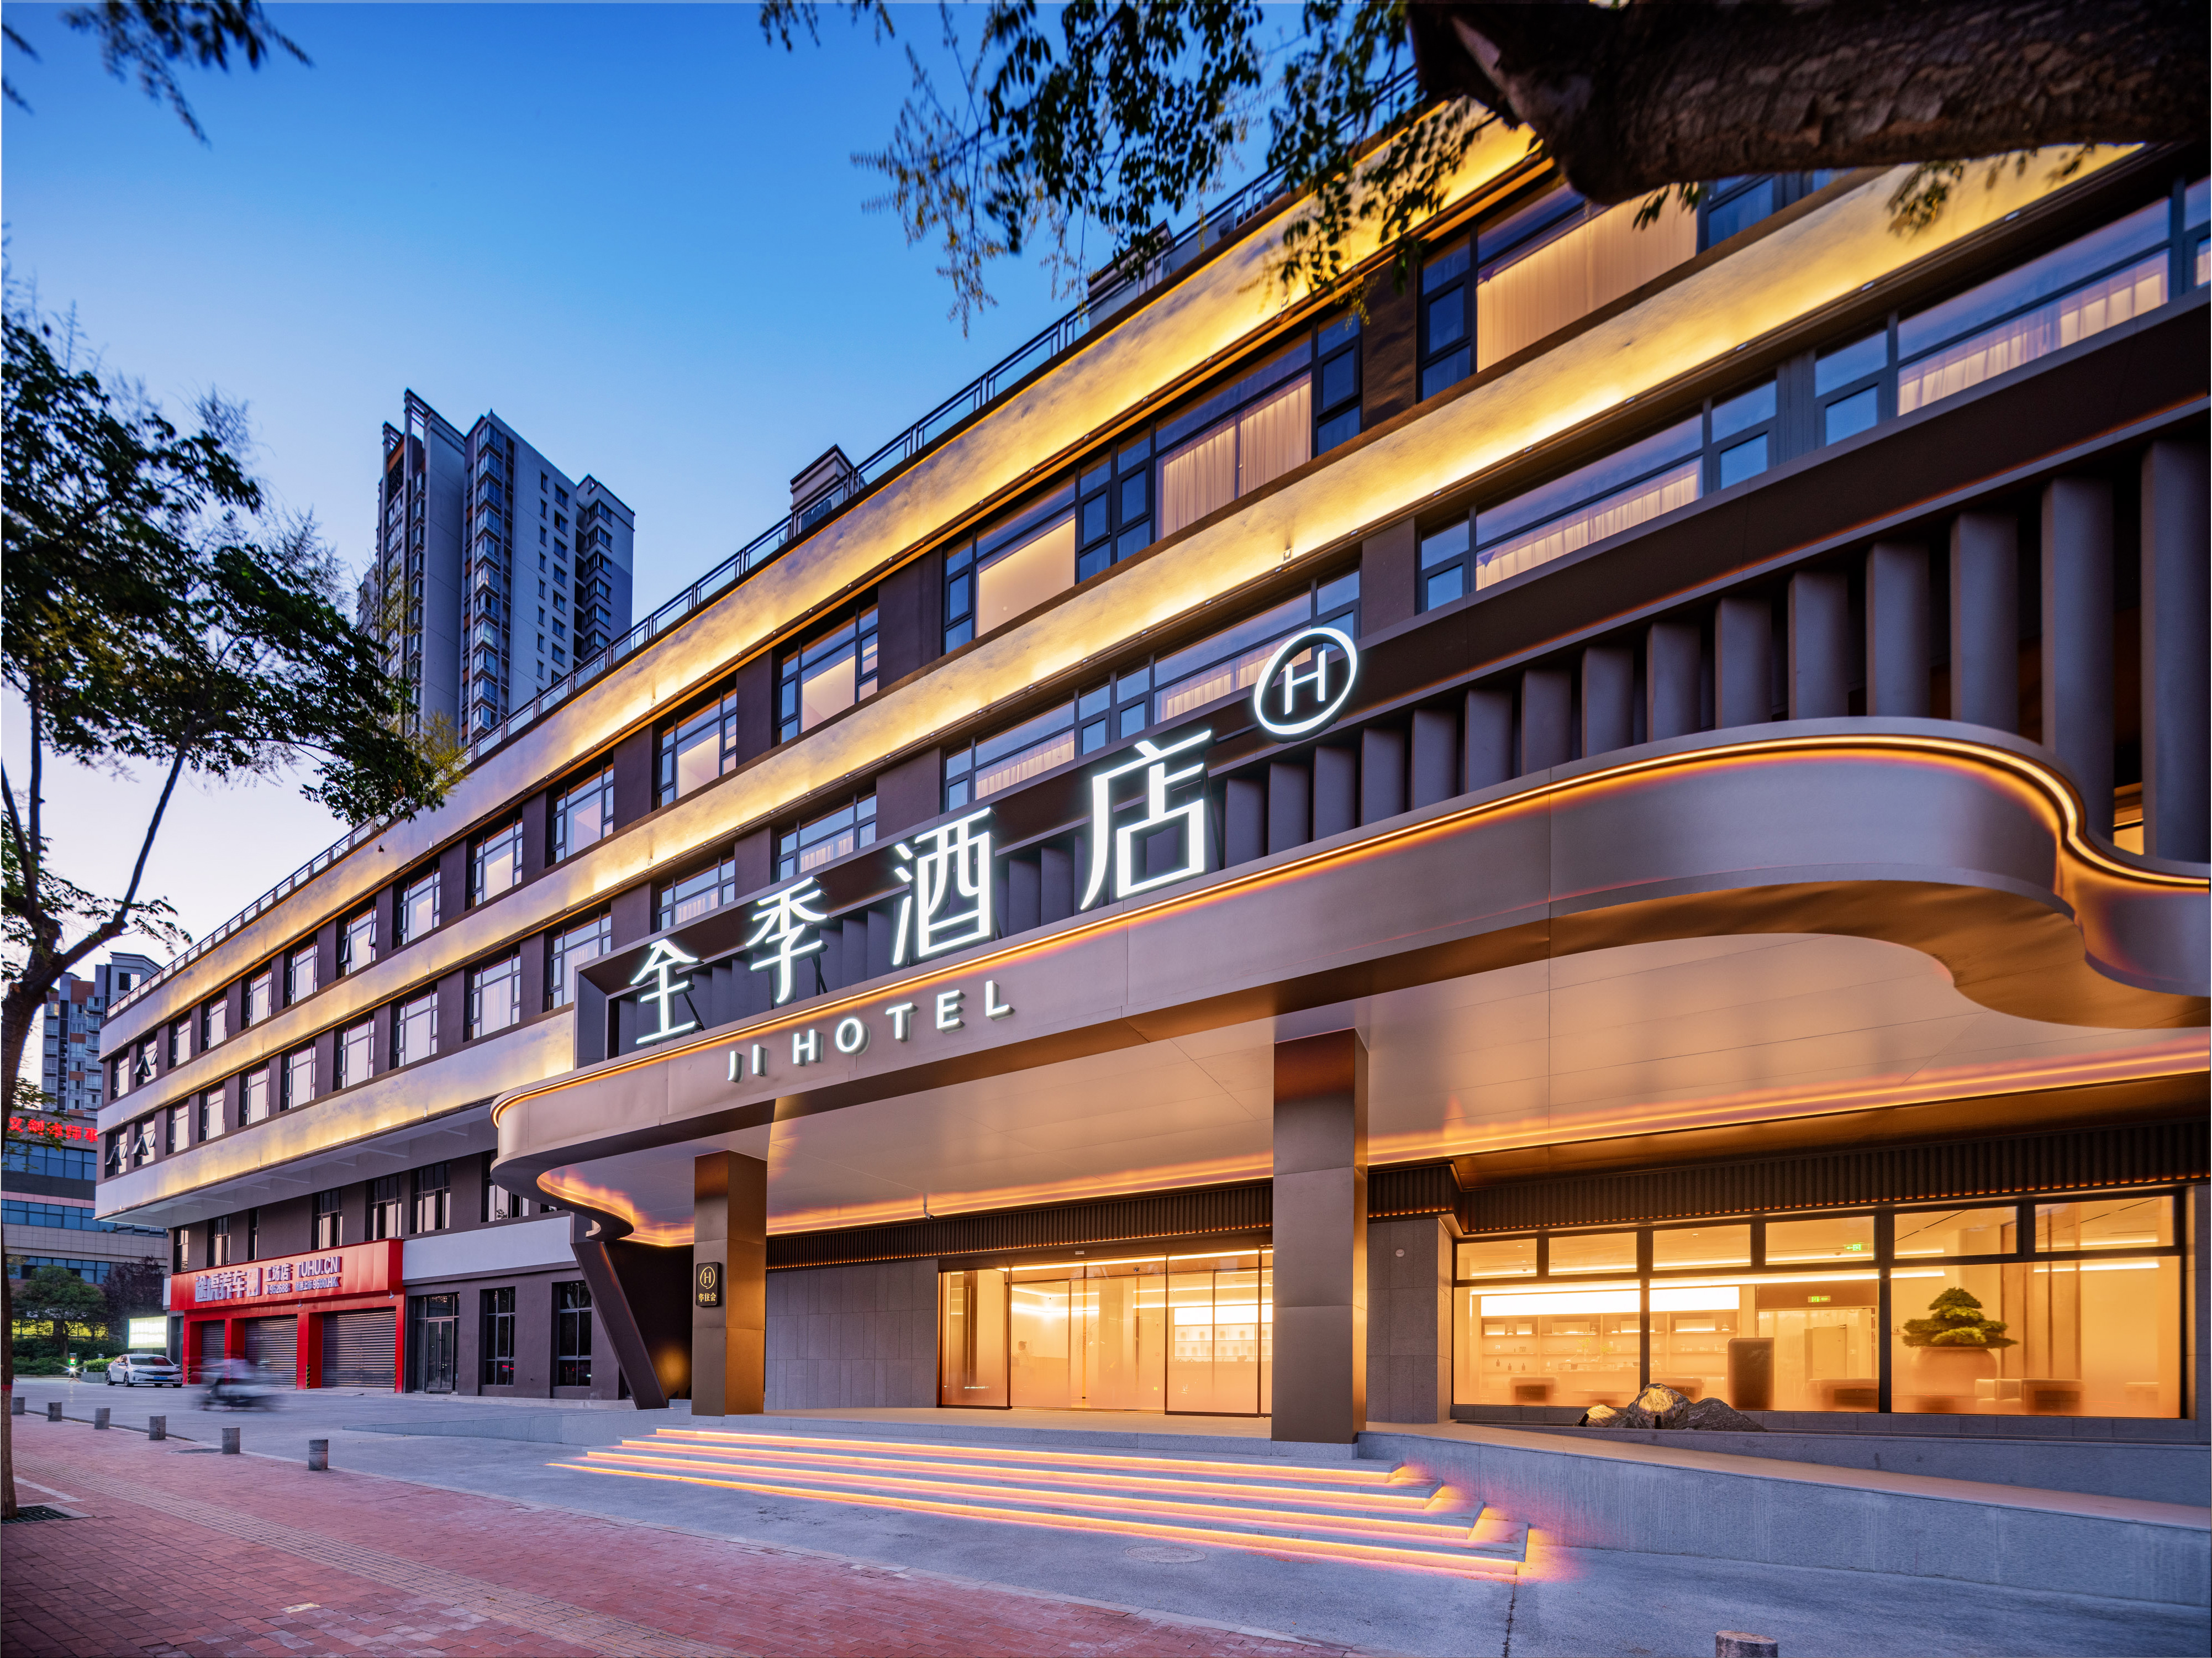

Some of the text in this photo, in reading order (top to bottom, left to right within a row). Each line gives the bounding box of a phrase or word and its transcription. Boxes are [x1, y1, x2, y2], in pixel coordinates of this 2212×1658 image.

[630, 729, 1212, 1045] 全季酒店
[728, 980, 1014, 1082] JI HOTEL
[264, 1263, 291, 1282] 工场店
[296, 1256, 340, 1277] TUHU.CN
[195, 1270, 247, 1302] 途虎养车
[698, 1292, 716, 1302] 华住会
